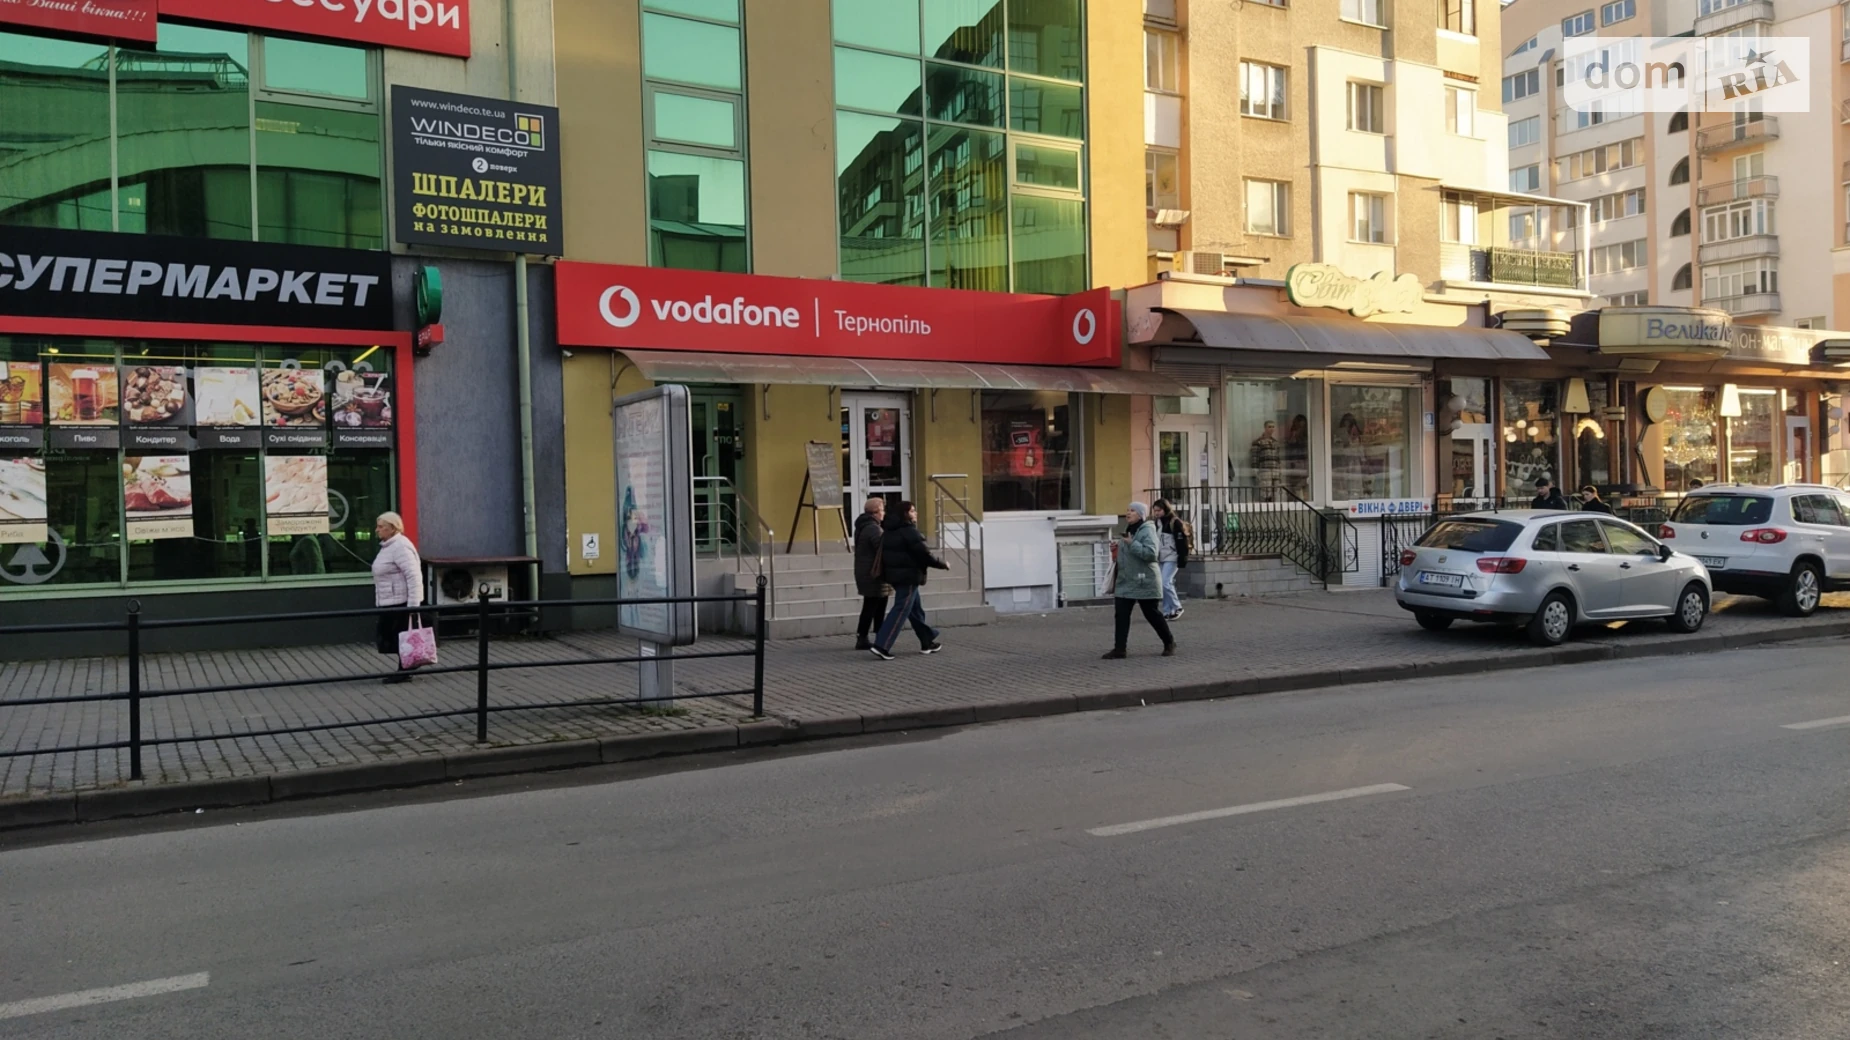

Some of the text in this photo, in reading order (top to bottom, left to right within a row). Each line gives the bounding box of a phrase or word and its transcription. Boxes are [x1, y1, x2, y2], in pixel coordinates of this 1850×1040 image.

[410, 98, 506, 119] www.windeco.te.ua
[410, 117, 530, 145] WINDECO
[412, 172, 547, 207] ШПАЛЕРИ
[412, 203, 547, 229] ФОТОШПАЛЕРИ
[413, 221, 548, 243] на замовлення
[650, 294, 800, 328] vodafone
[833, 309, 931, 336] Тернопіль
[74, 434, 97, 443] Пиво
[135, 435, 177, 444] Кондитер
[219, 435, 241, 443] Вода
[268, 434, 287, 444] Сухі
[1358, 501, 1423, 514] ВІКНА ДВЕРІ
